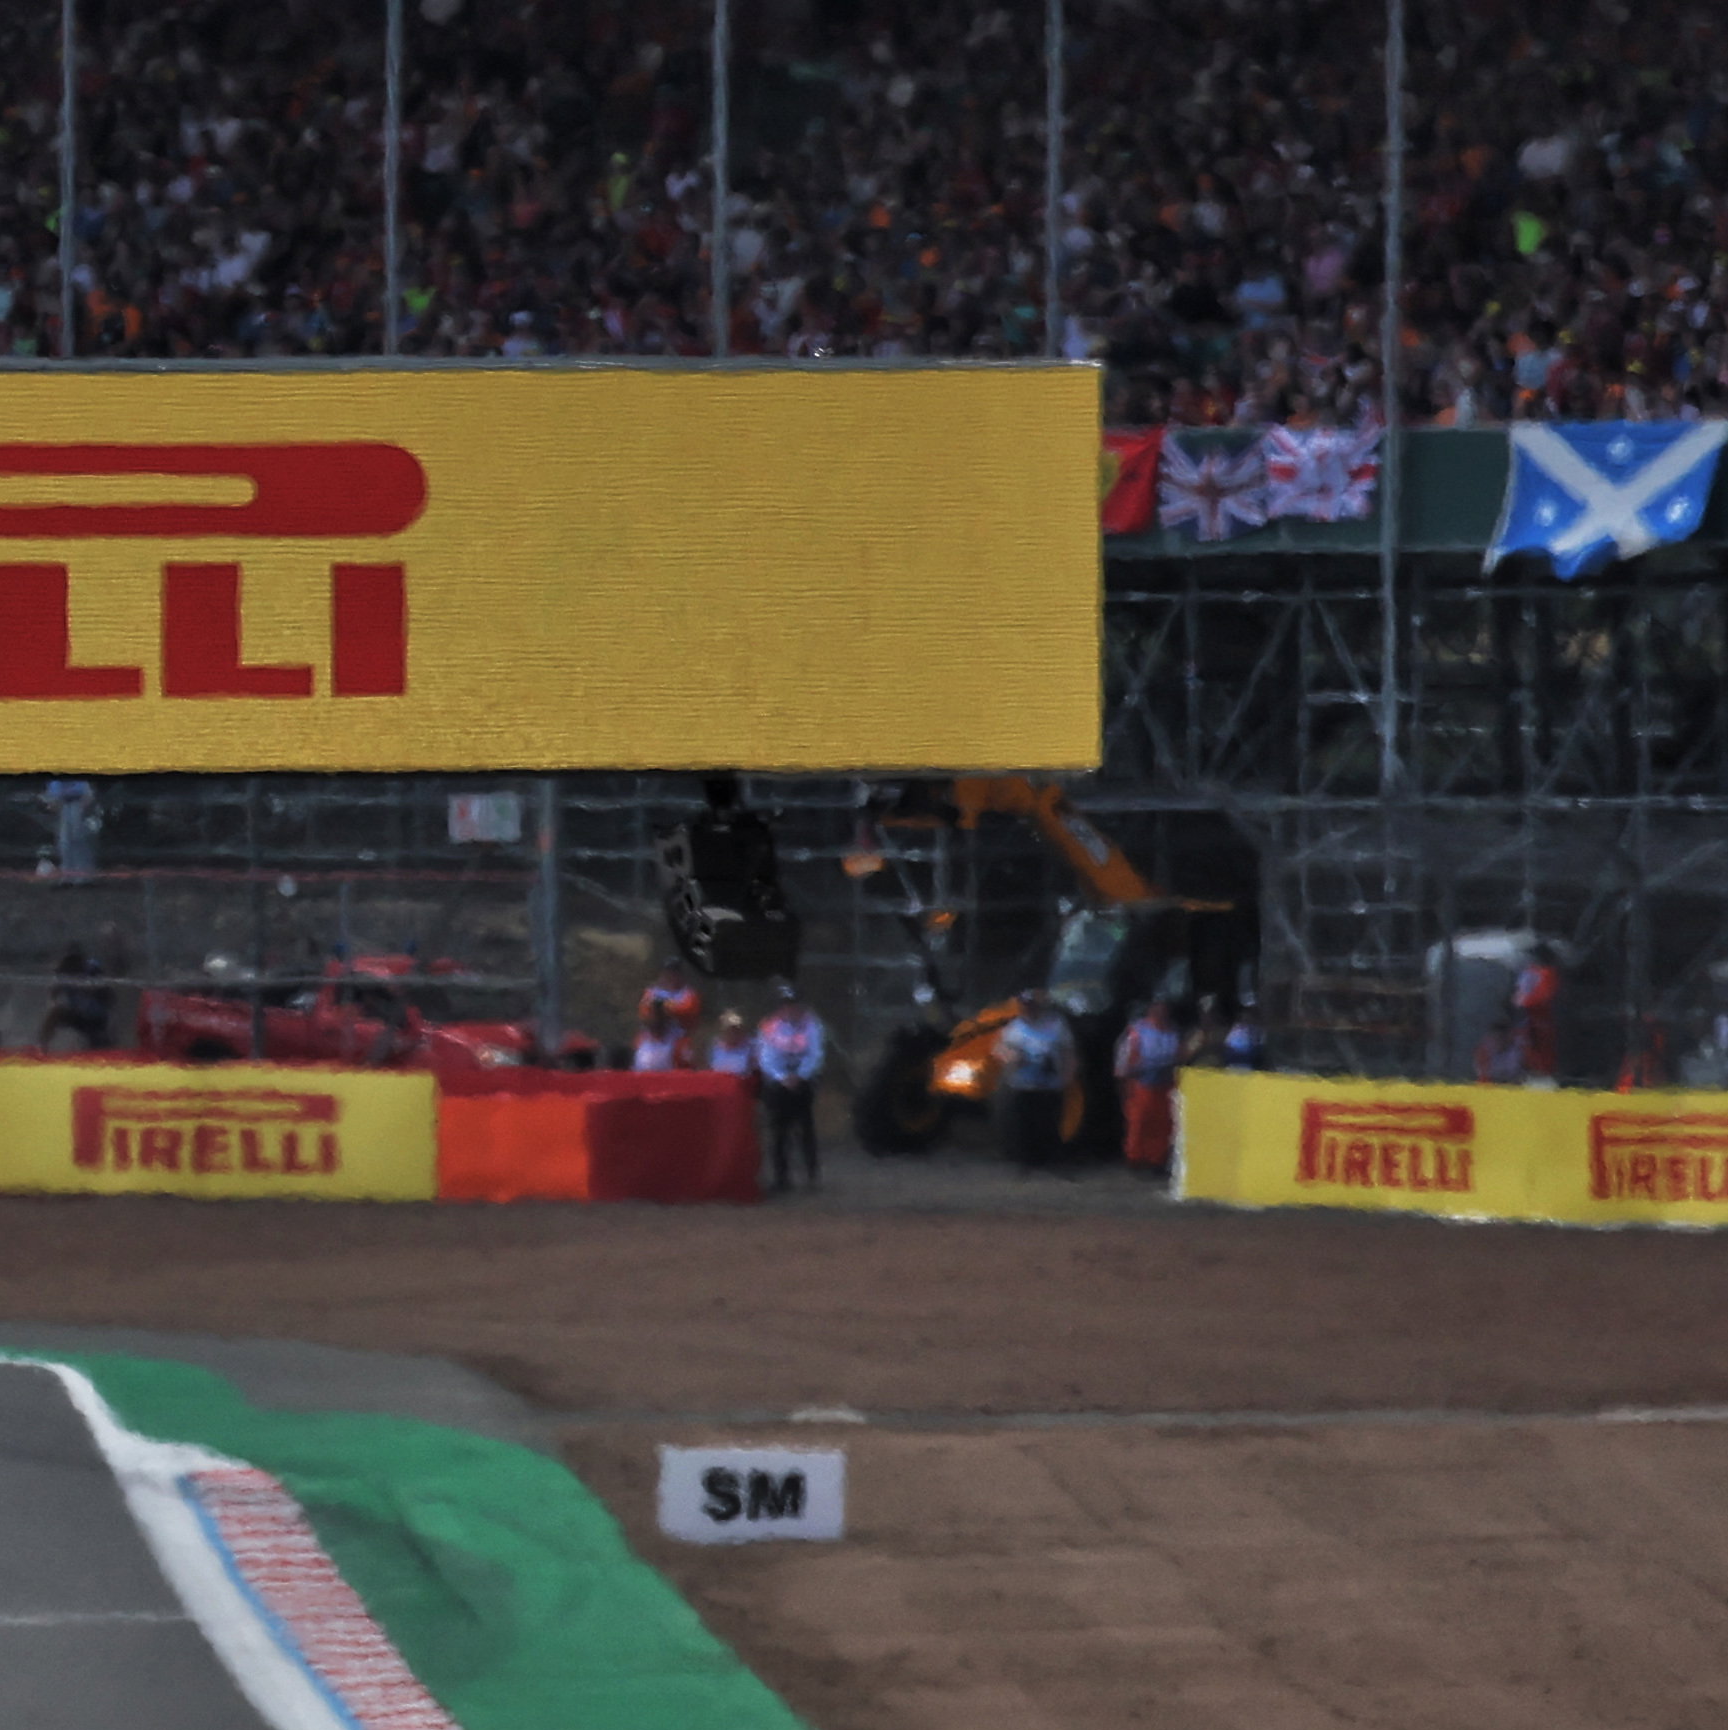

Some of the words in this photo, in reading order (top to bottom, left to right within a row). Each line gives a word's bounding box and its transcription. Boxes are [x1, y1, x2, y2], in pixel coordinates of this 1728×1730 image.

[71, 1085, 339, 1175] PIRELLI
[1296, 1098, 1474, 1193] PIRELLI
[1587, 1110, 1728, 1202] PIREL
[701, 1465, 807, 1524] SM
